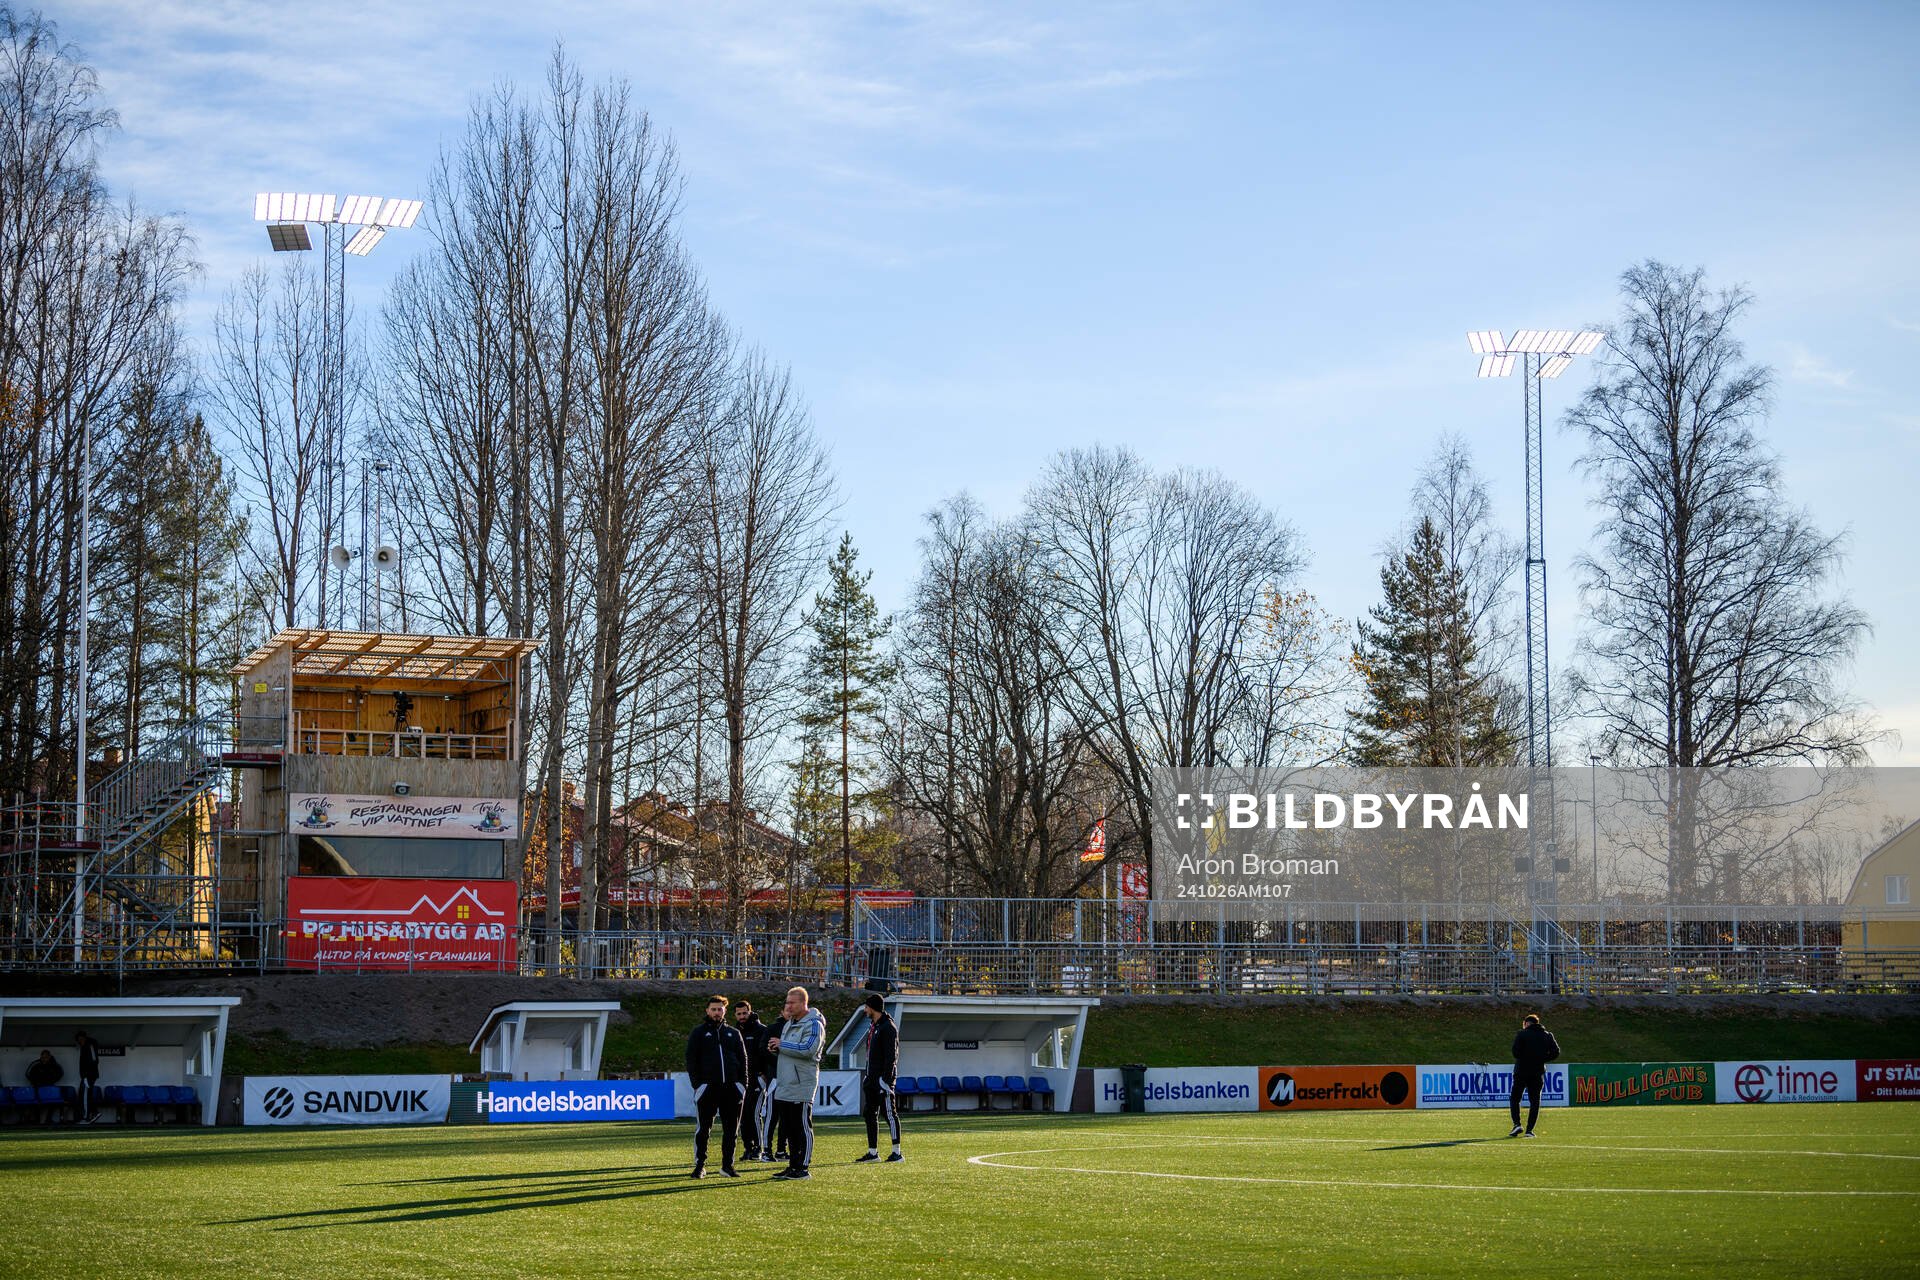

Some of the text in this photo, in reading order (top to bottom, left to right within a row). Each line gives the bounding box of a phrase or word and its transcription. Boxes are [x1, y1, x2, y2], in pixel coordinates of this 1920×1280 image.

[350, 804, 462, 819] RESTAURANGEN
[361, 815, 447, 828] VID VATTNET
[474, 922, 505, 940] AB
[314, 950, 351, 961] ALLTID
[355, 947, 372, 961] PÅ
[374, 950, 427, 961] KUNDENS
[1864, 1068, 1883, 1081] JT
[1104, 1081, 1250, 1101] Hadelsbanken
[1269, 1079, 1379, 1100] MaserFrakt
[1655, 1084, 1704, 1100] PUB
[1877, 1087, 1893, 1096] Ditt
[304, 1089, 429, 1113] SANDVIK
[477, 1090, 650, 1113] Handelsbanken
